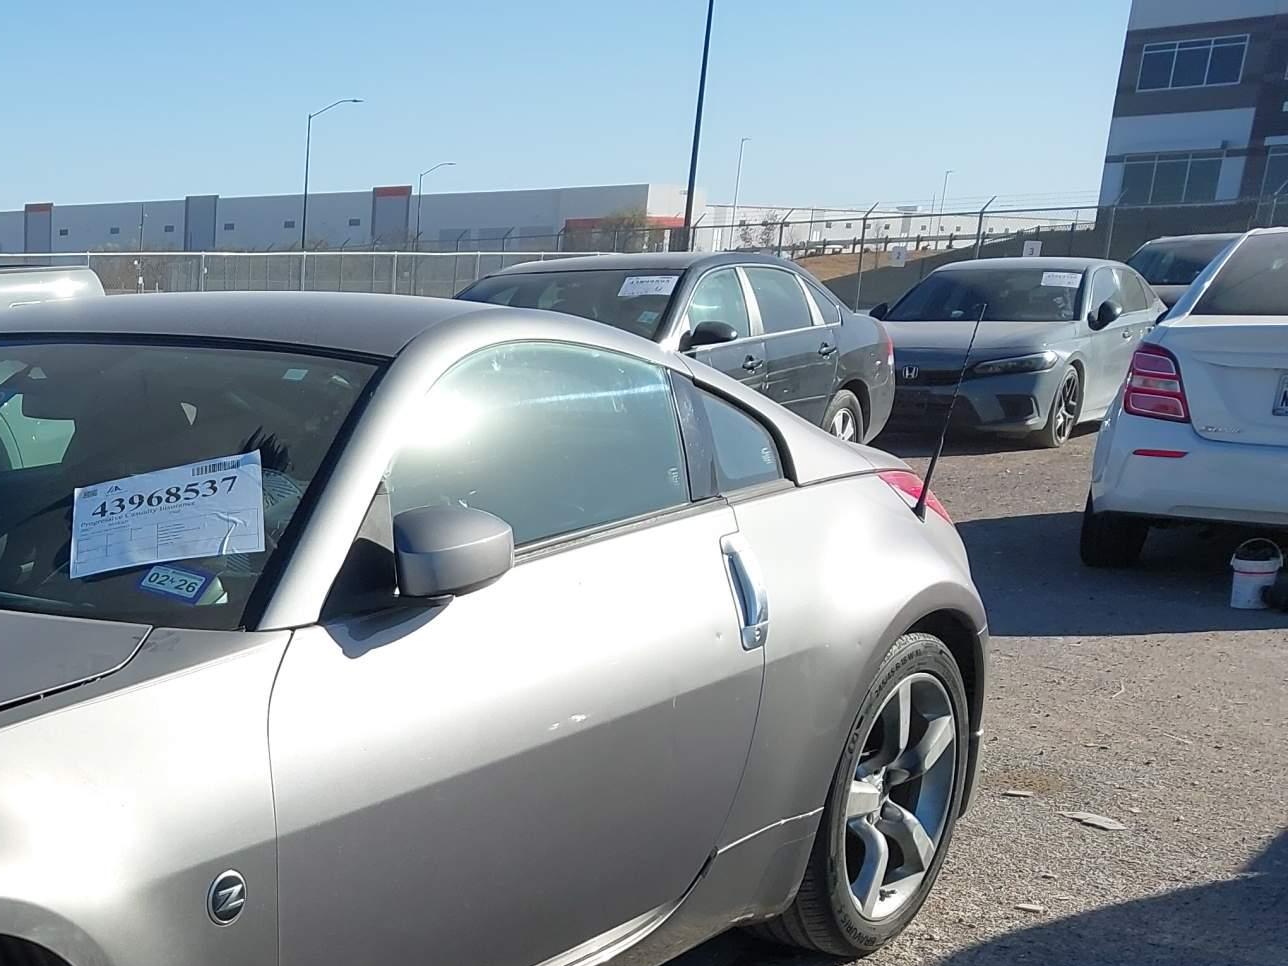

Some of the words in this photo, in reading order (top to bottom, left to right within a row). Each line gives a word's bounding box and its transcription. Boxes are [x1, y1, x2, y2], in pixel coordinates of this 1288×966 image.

[91, 475, 238, 518] 43968537
[148, 572, 170, 586] 02
[174, 578, 198, 593] 26
